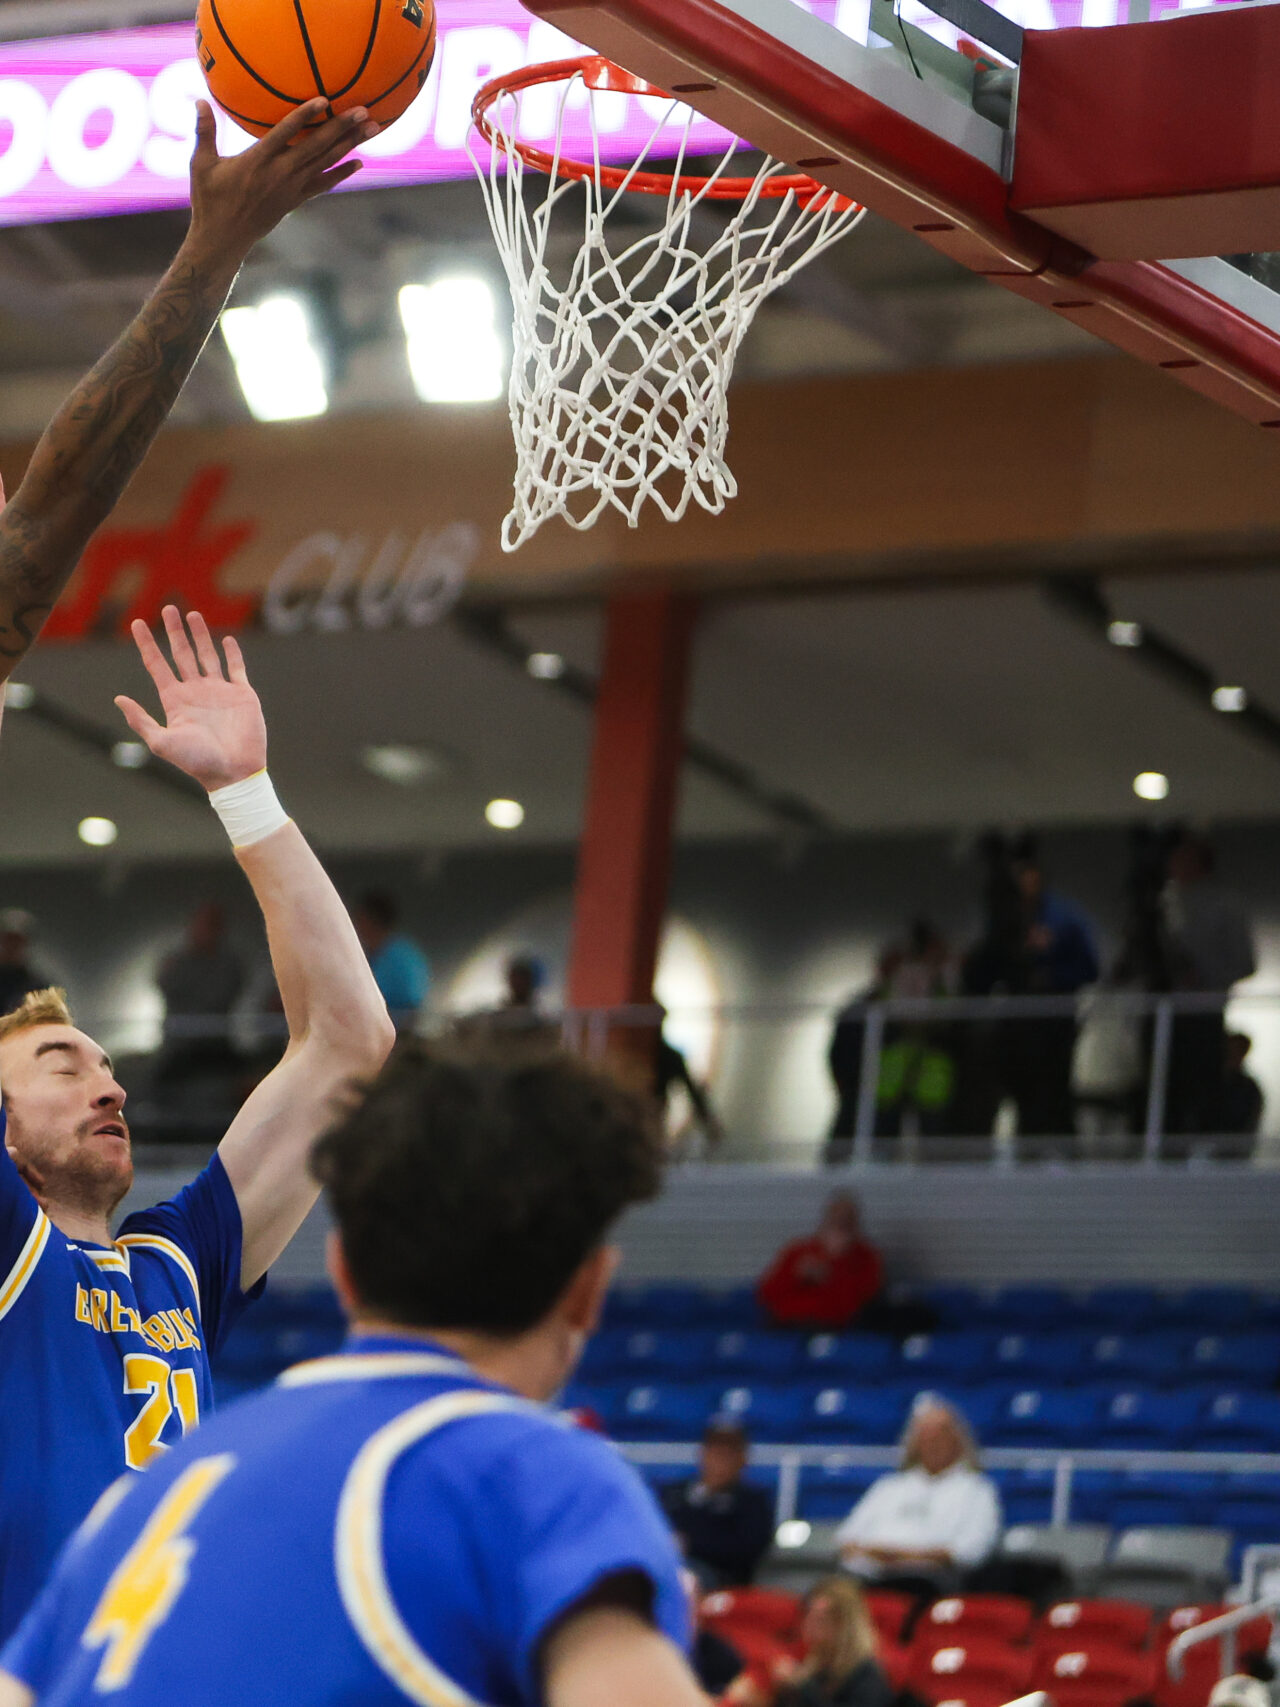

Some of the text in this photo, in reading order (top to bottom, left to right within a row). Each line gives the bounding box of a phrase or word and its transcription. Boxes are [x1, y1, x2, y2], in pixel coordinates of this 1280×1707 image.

[263, 520, 478, 635] CLUB
[123, 1353, 201, 1473] 21
[81, 1452, 238, 1693] 4
